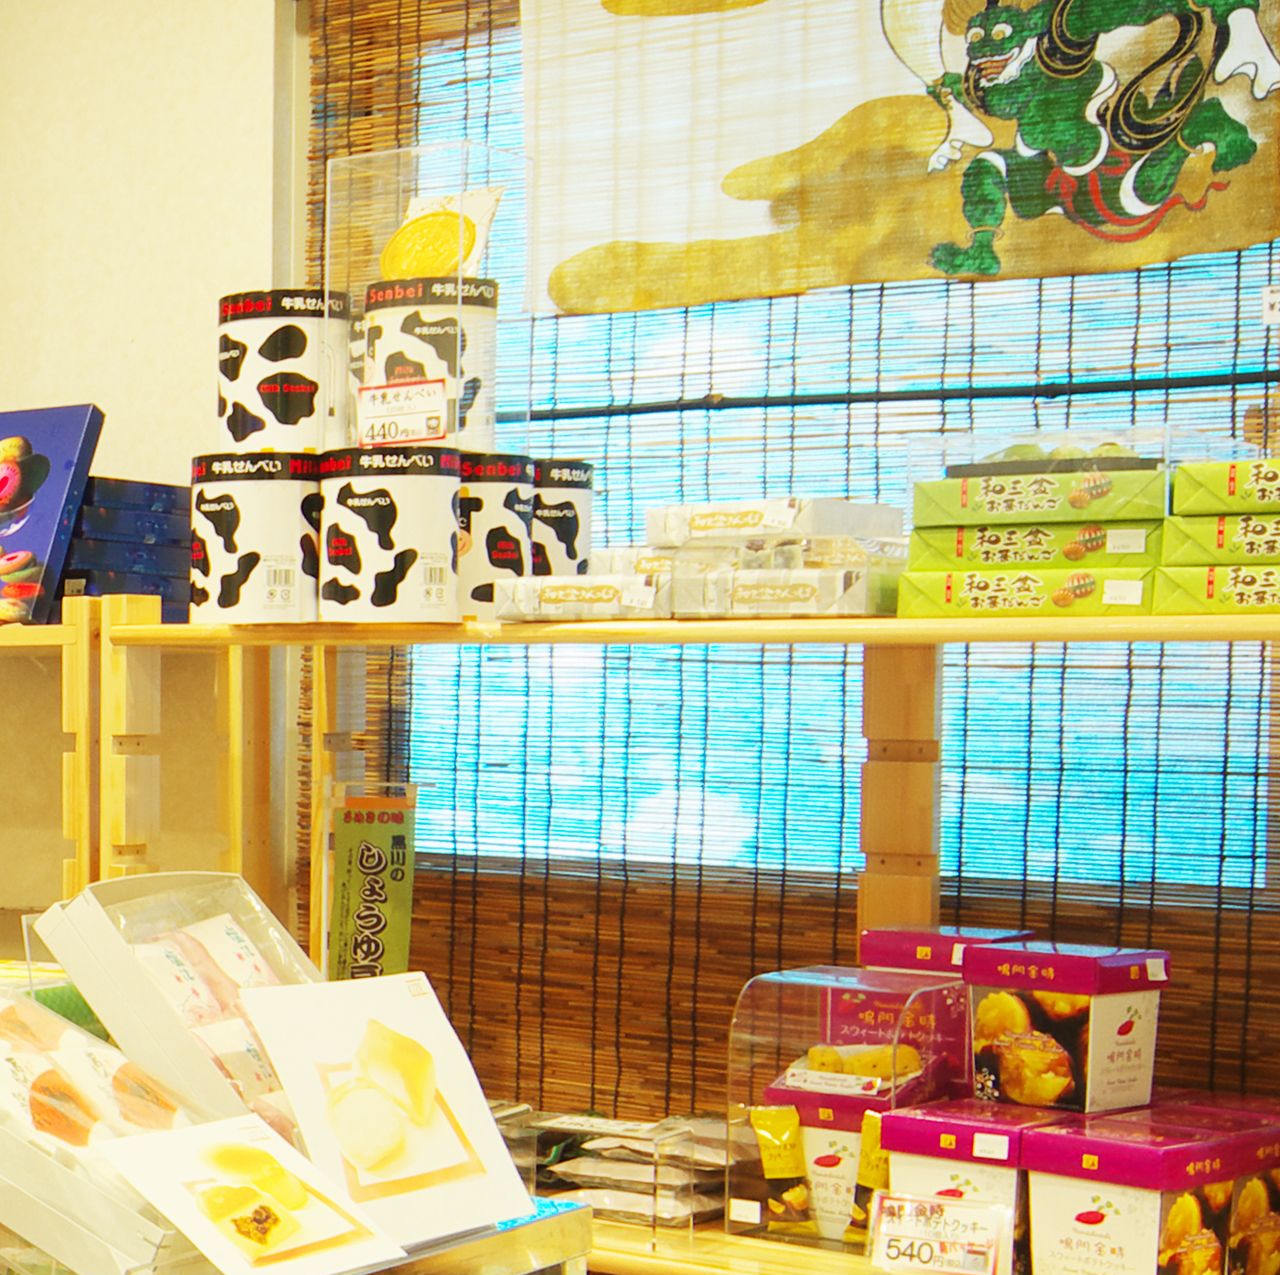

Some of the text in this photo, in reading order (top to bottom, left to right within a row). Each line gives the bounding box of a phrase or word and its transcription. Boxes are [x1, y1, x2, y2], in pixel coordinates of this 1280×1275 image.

[371, 283, 423, 303] Senbei
[365, 421, 398, 442] 440
[211, 457, 282, 475] 牛乳せんべい
[360, 452, 434, 470] 牛乳せんべい
[978, 476, 1059, 498] 和三盆
[973, 526, 1055, 549] 和三盆
[962, 571, 1043, 595] 和三盆
[390, 834, 406, 883] 黒川の
[885, 1238, 934, 1265] 540
